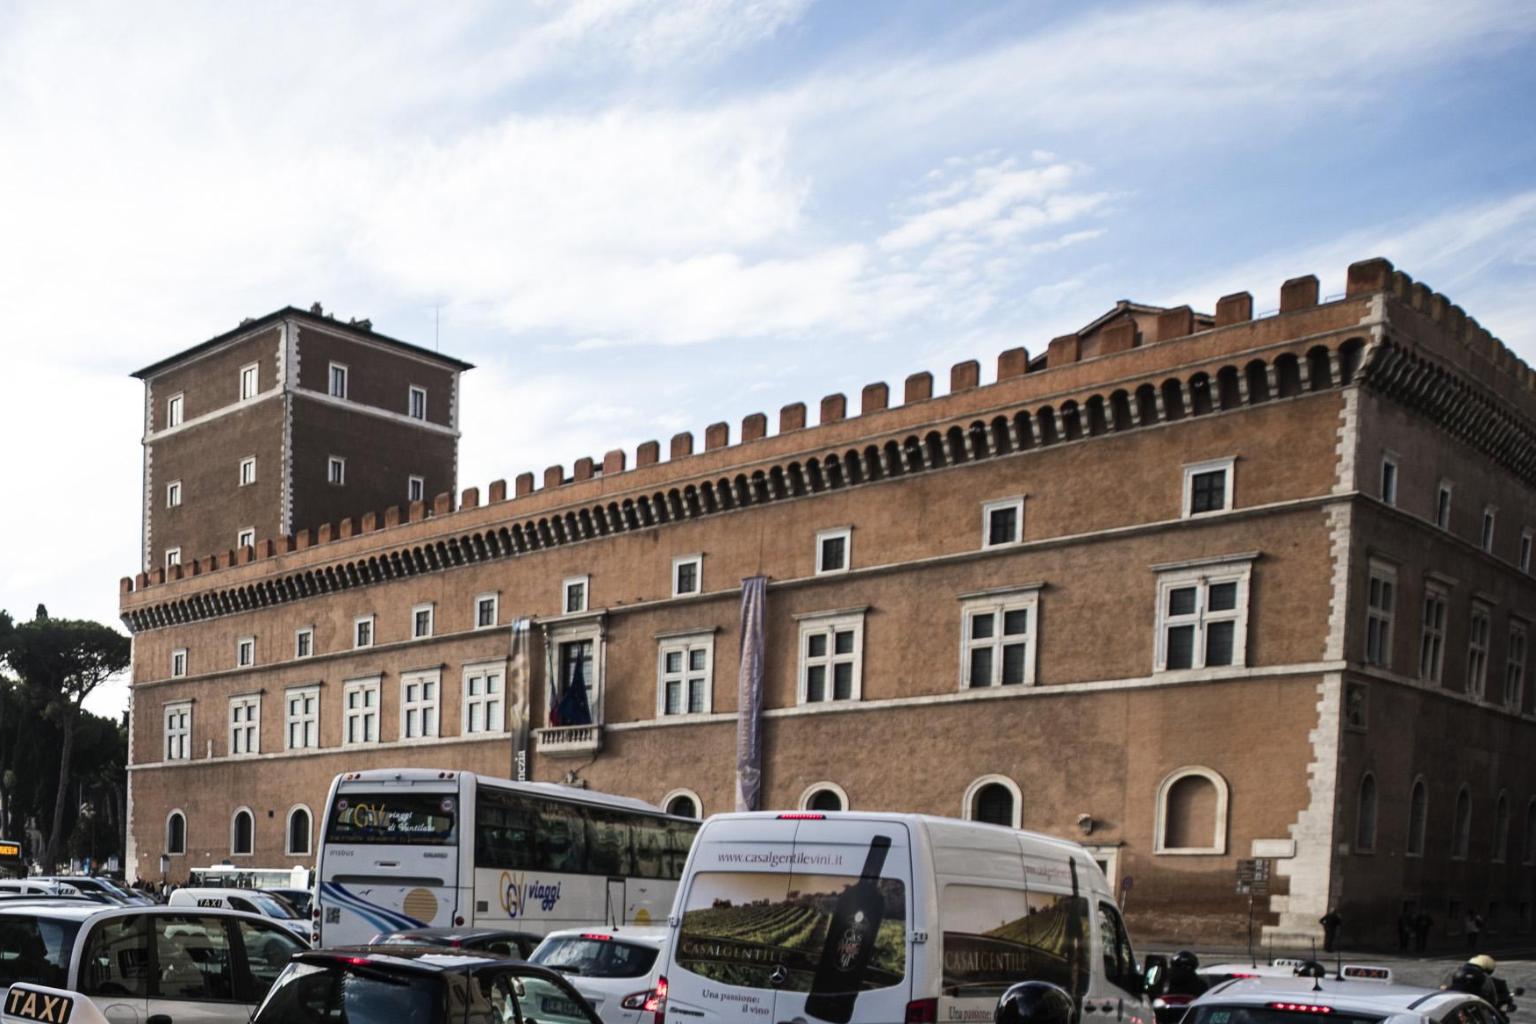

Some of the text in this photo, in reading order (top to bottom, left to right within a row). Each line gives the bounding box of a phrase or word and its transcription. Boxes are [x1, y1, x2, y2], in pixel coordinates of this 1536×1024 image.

[717, 851, 843, 867] www.casalgentilevini.it
[197, 899, 222, 908] TAXI
[529, 880, 561, 911] viaggi
[682, 942, 786, 962] CASALGENTILE
[945, 950, 1027, 972] CASALGENTILE
[702, 989, 760, 1004] Una passione:
[10, 989, 68, 1024] TAXI
[742, 1005, 769, 1016] il vino
